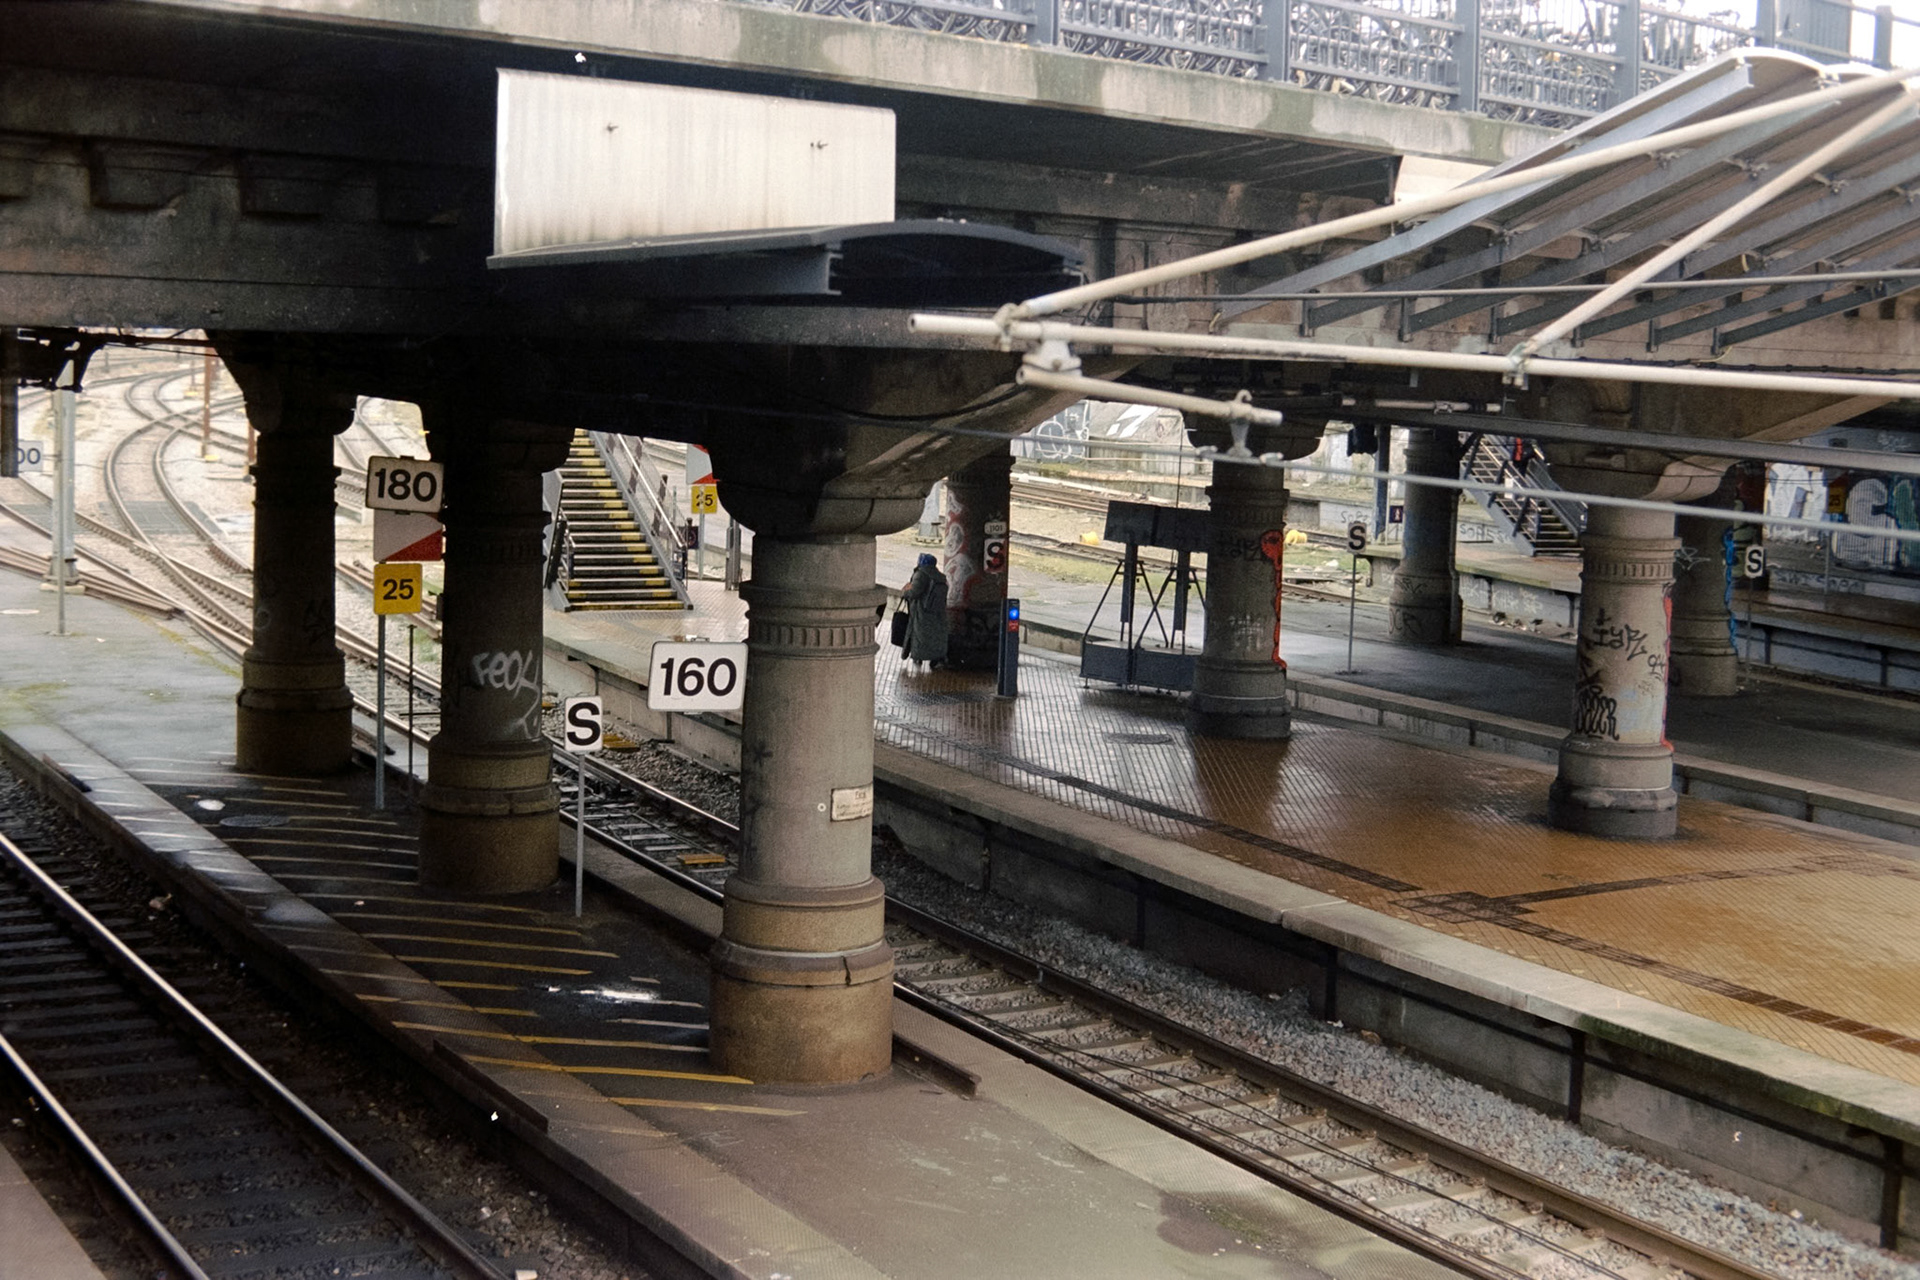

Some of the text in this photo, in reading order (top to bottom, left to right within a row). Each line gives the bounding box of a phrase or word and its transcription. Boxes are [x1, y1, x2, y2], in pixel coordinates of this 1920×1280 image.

[375, 468, 437, 502] 180
[1349, 525, 1366, 550] S
[986, 541, 1005, 569] S
[1748, 549, 1762, 573] S
[383, 579, 414, 601] 25
[660, 657, 737, 697] 160
[567, 702, 601, 746] S
